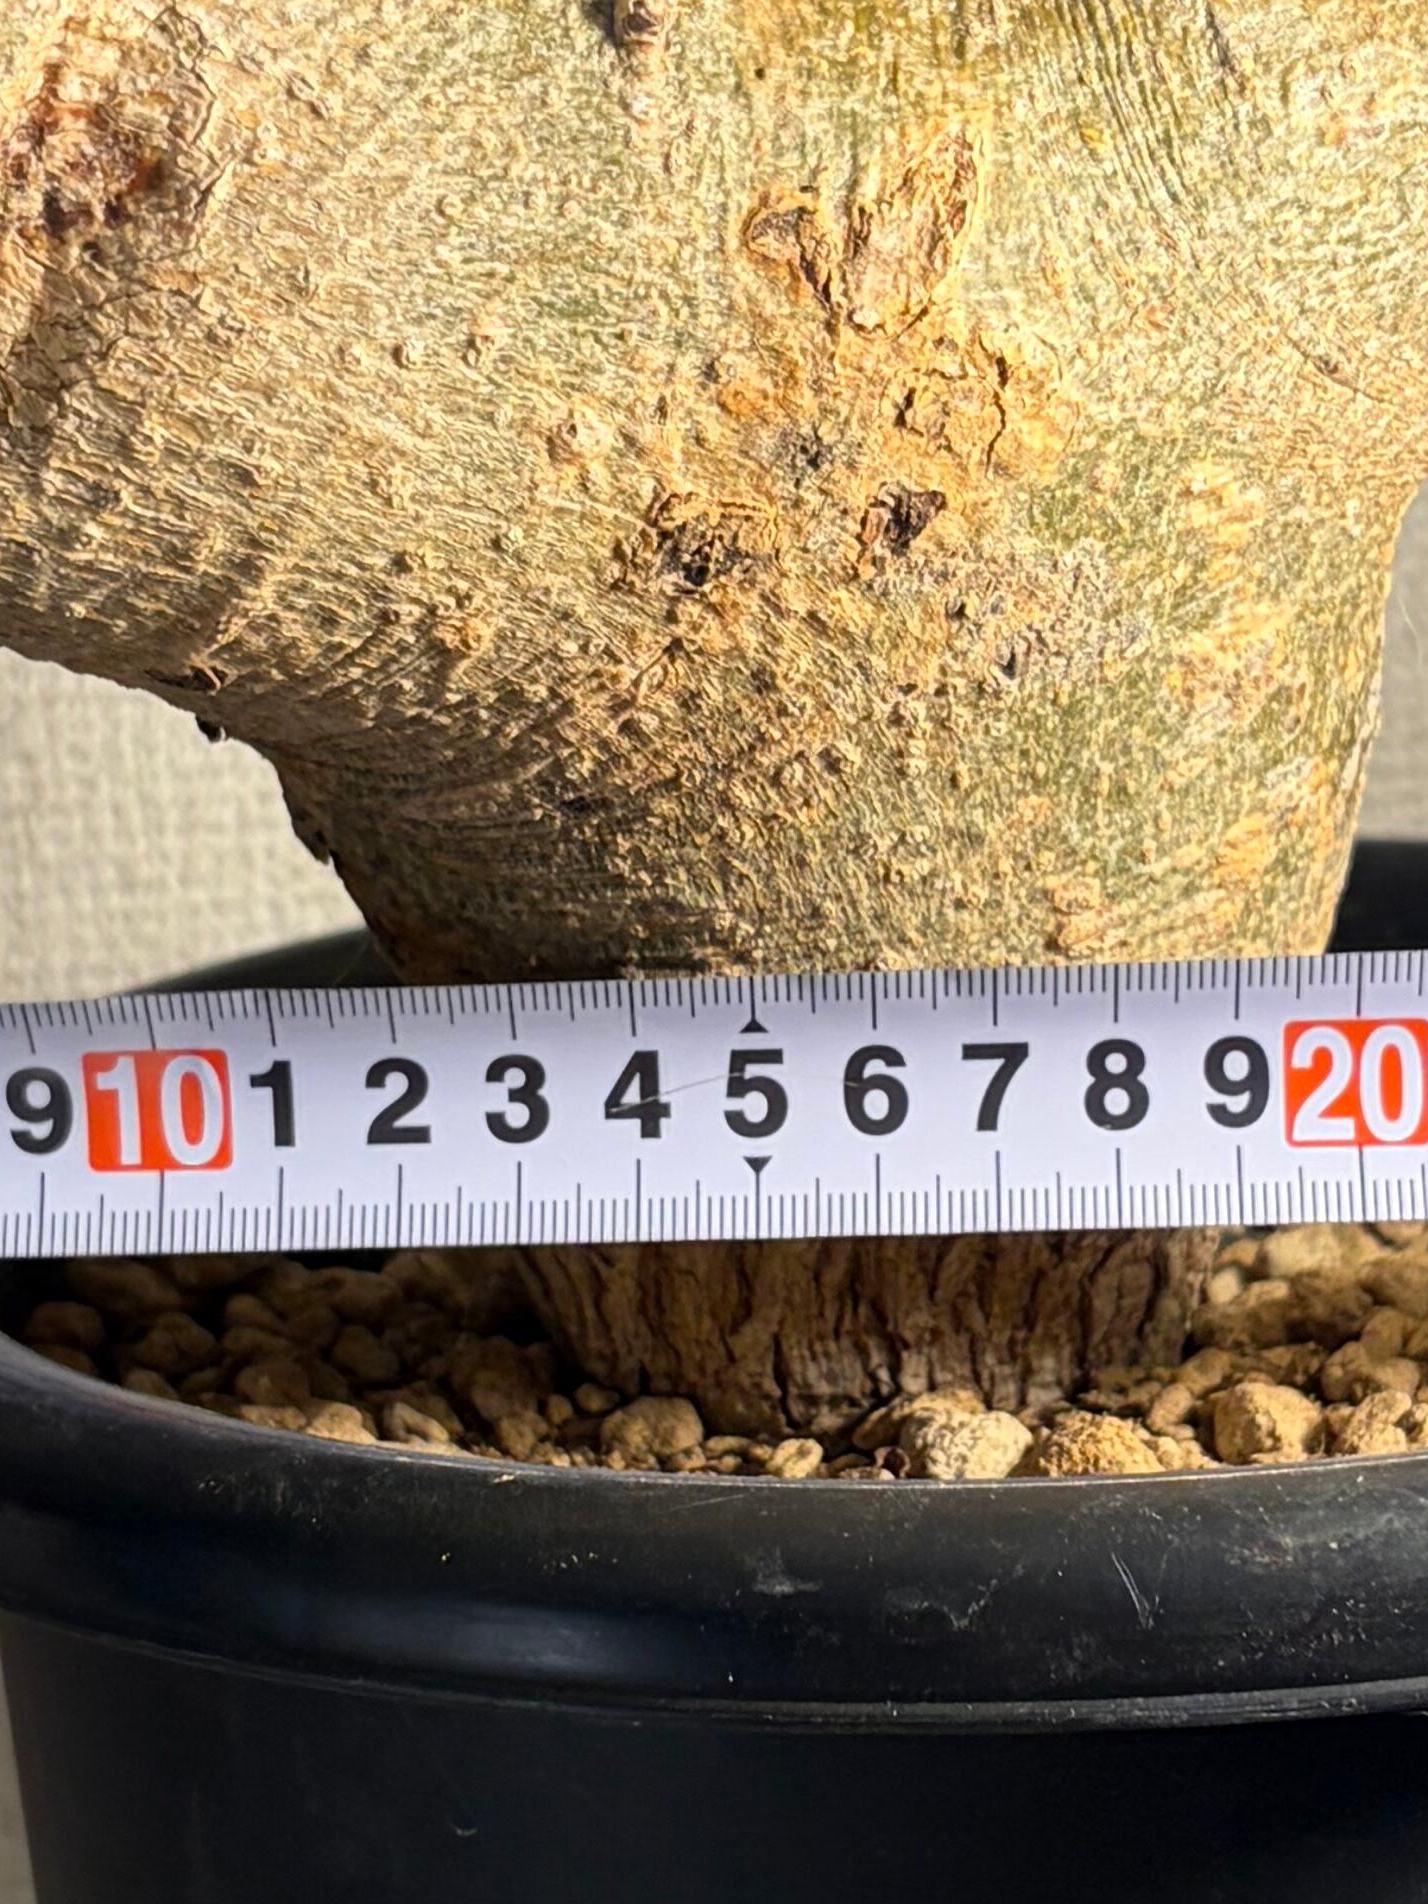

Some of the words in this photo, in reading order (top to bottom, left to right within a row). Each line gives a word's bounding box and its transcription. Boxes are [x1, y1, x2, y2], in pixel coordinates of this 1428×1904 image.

[5, 1067, 73, 1155] 9
[96, 1054, 224, 1166] 10
[249, 1060, 295, 1147] 1
[365, 1057, 431, 1145] 2
[485, 1054, 550, 1144] 3
[604, 1050, 671, 1139] 4
[724, 1048, 788, 1138] 5
[843, 1044, 908, 1136] 6
[962, 1042, 1029, 1131] 7
[1084, 1039, 1149, 1130] 8
[1204, 1036, 1269, 1128] 9
[1291, 1025, 1423, 1142] 20
